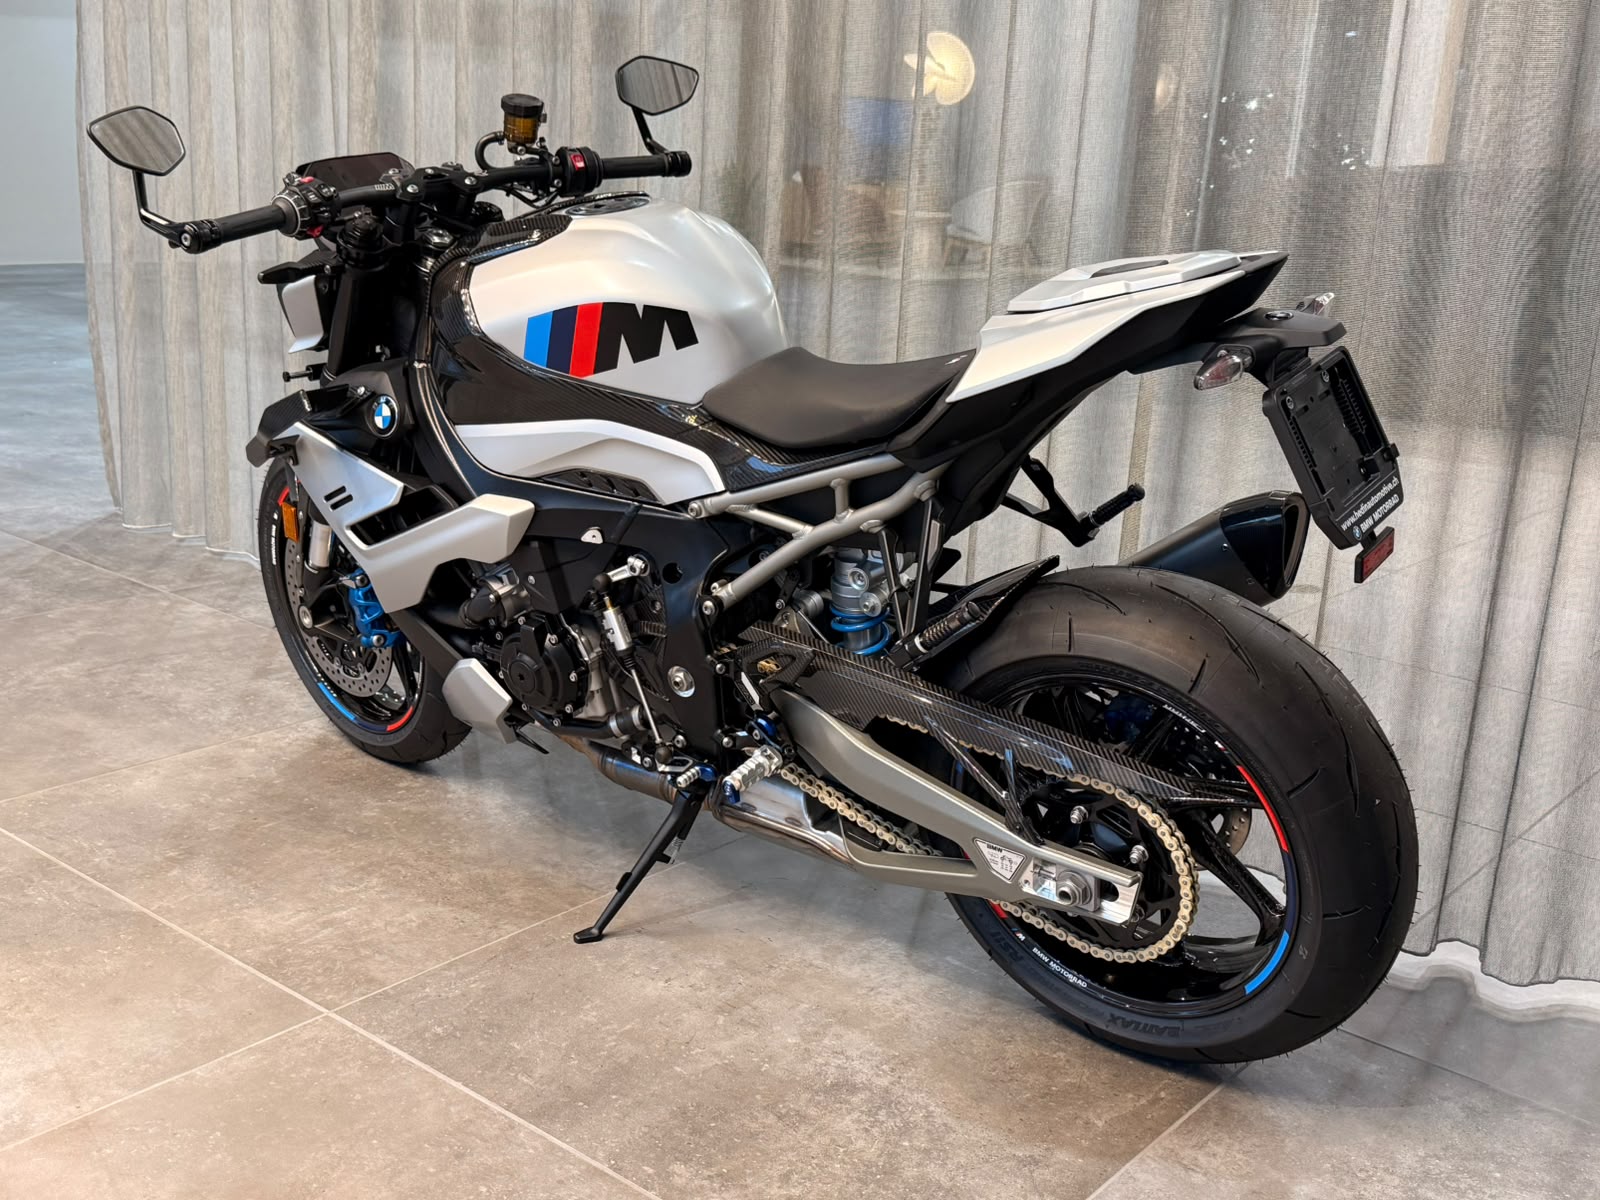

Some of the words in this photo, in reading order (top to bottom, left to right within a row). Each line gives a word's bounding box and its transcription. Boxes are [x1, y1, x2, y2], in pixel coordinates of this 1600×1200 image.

[593, 302, 699, 375] M
[1360, 515, 1375, 533] BMW
[1373, 494, 1400, 522] MOTORRAD
[986, 843, 1003, 853] BMW
[1032, 947, 1050, 963] BMW
[1049, 961, 1087, 988] MOTORRAD
